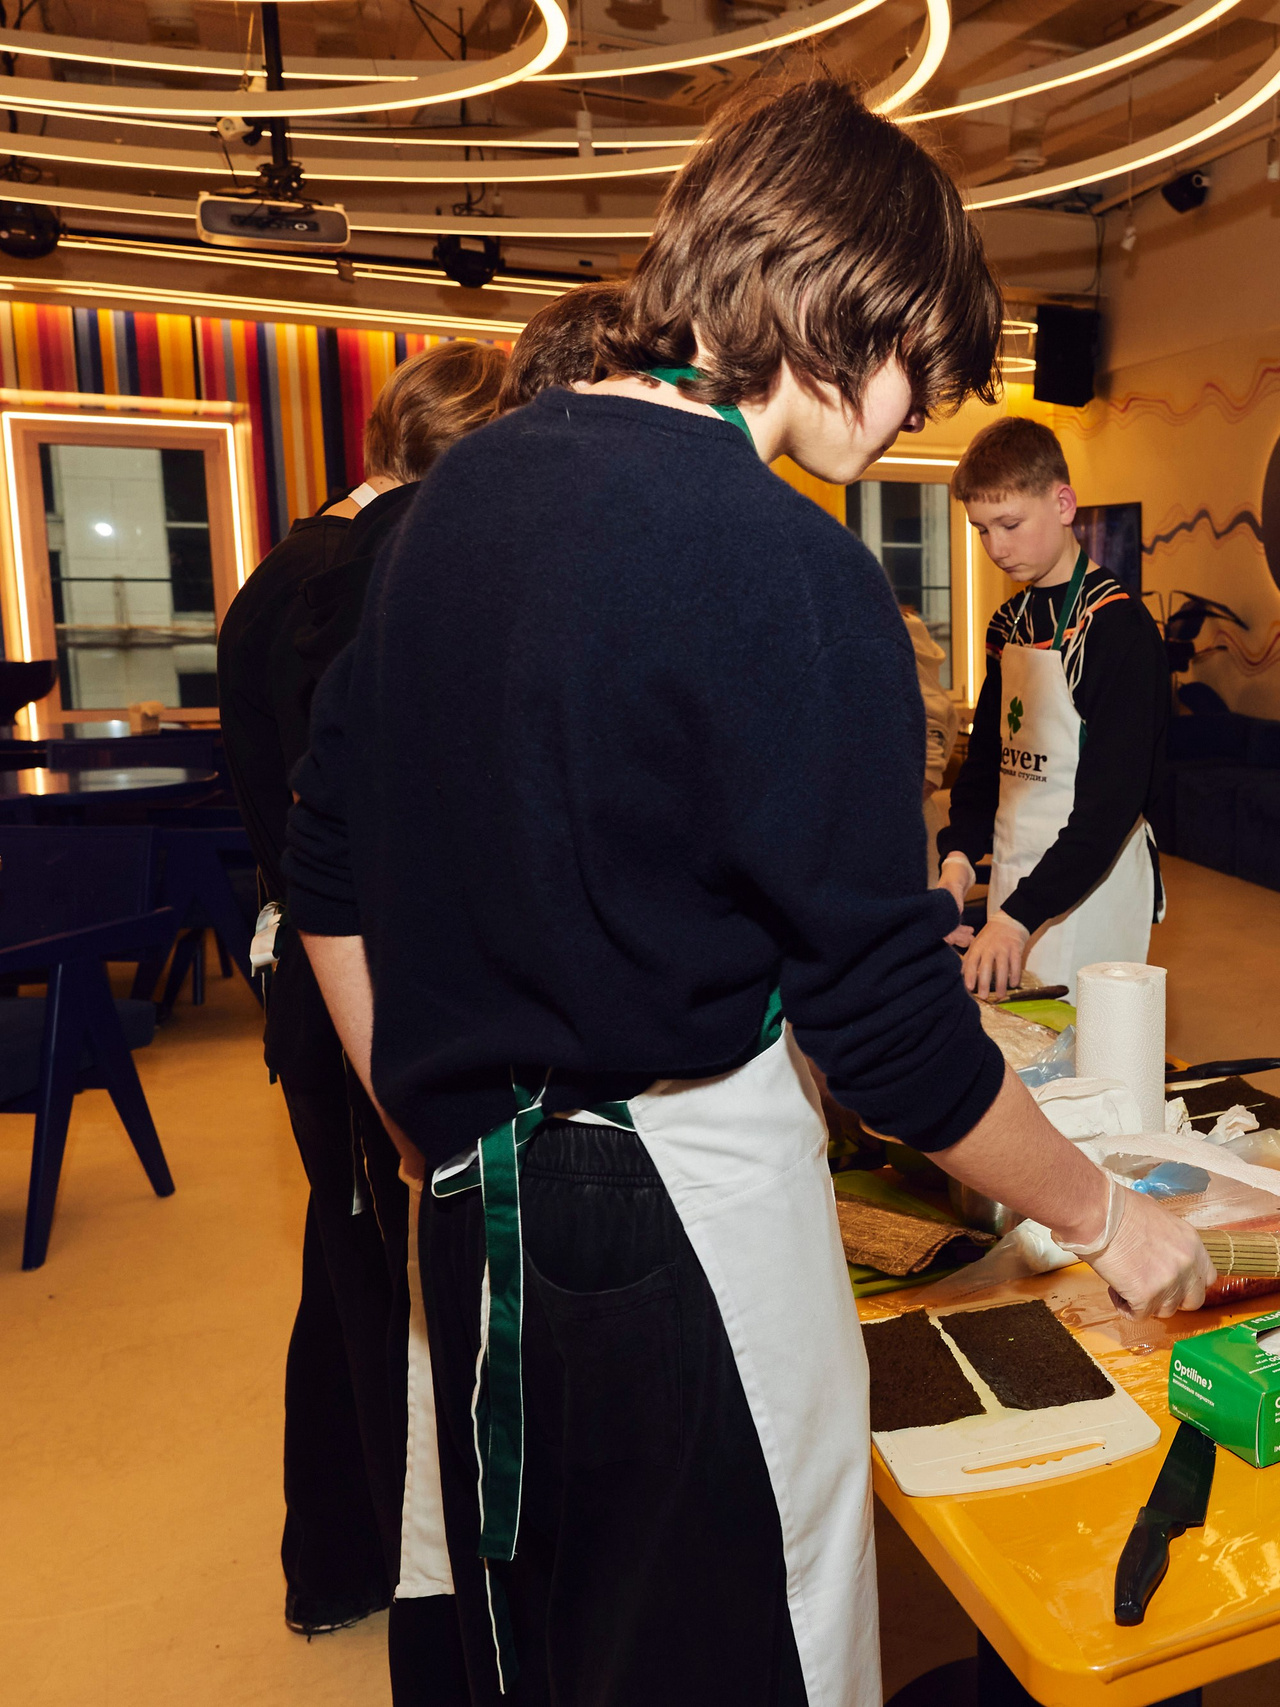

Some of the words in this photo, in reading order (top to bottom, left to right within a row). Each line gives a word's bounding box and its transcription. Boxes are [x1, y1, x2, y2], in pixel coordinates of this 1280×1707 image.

[1001, 747, 1047, 772] ever
[1018, 771, 1047, 783] студия
[1174, 1359, 1208, 1388] Optiline
